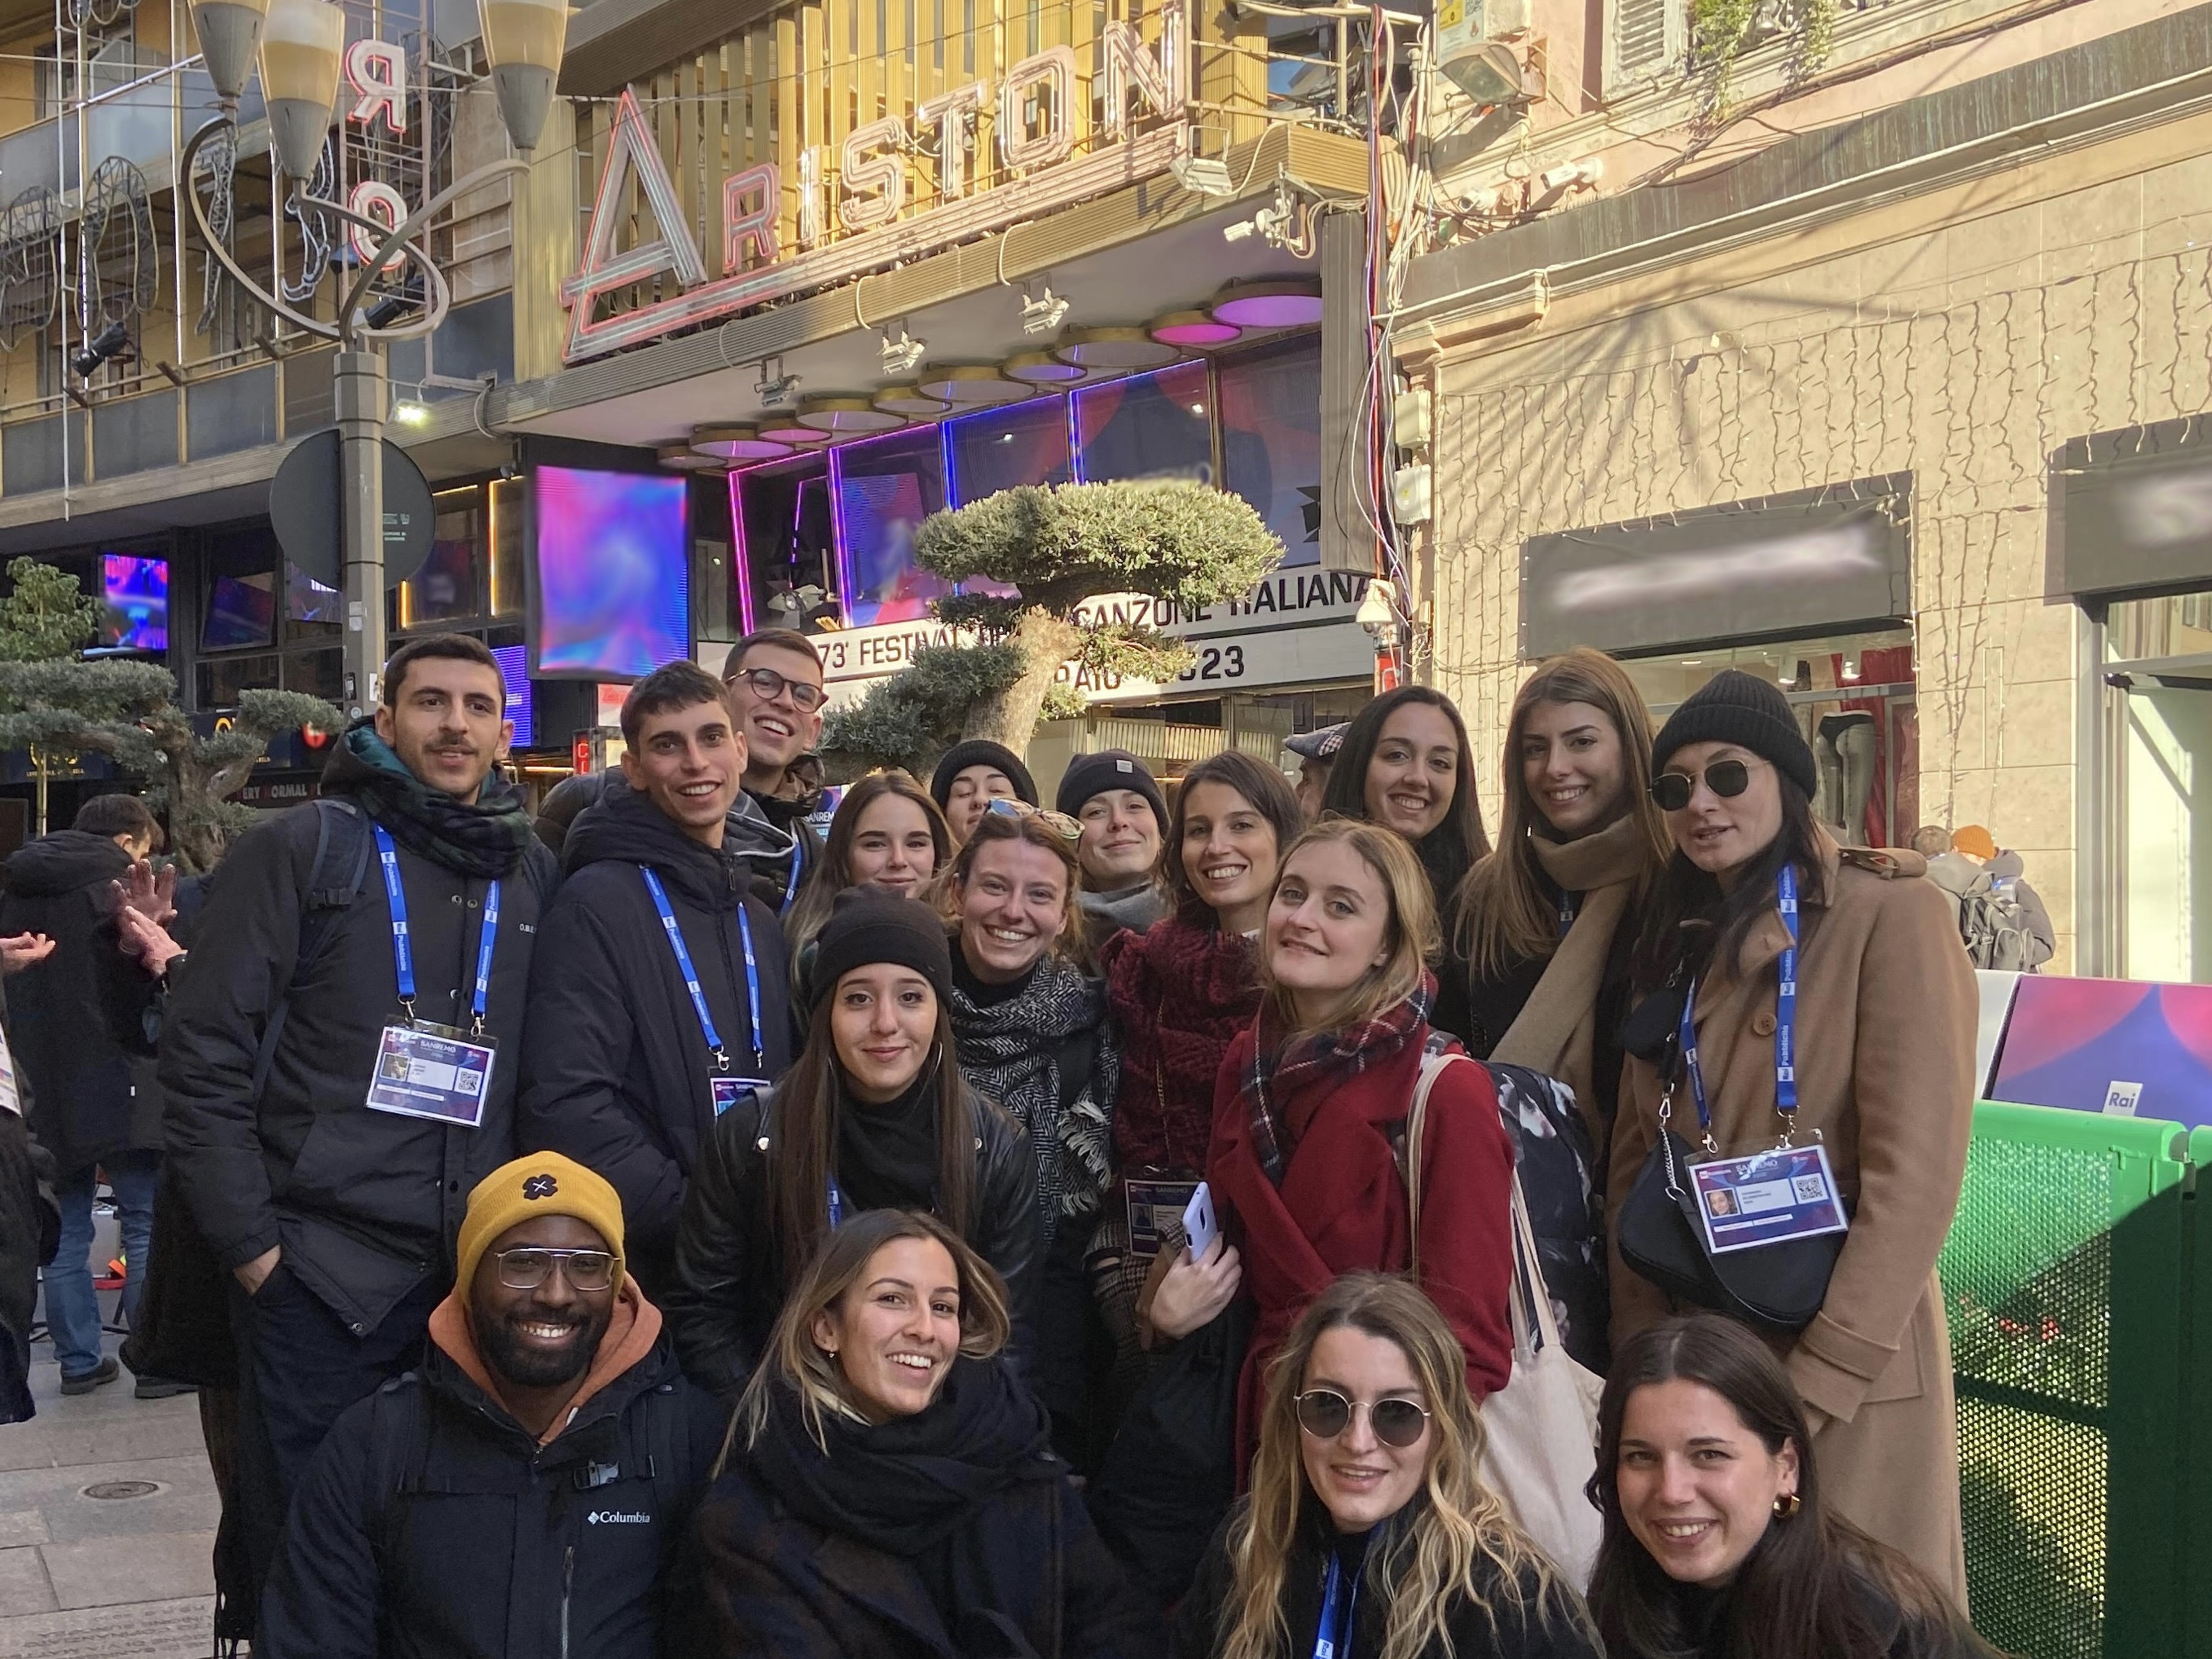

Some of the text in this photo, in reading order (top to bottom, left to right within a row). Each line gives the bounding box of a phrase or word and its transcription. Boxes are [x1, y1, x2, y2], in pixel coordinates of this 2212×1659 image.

[560, 1, 1189, 364] ARISTON
[803, 811, 835, 822] SANREM
[420, 1039, 456, 1053] SANREMO
[2108, 1092, 2136, 1108] Rai
[1736, 1160, 1777, 1172] SAEMO
[600, 1511, 650, 1523] Columbia
